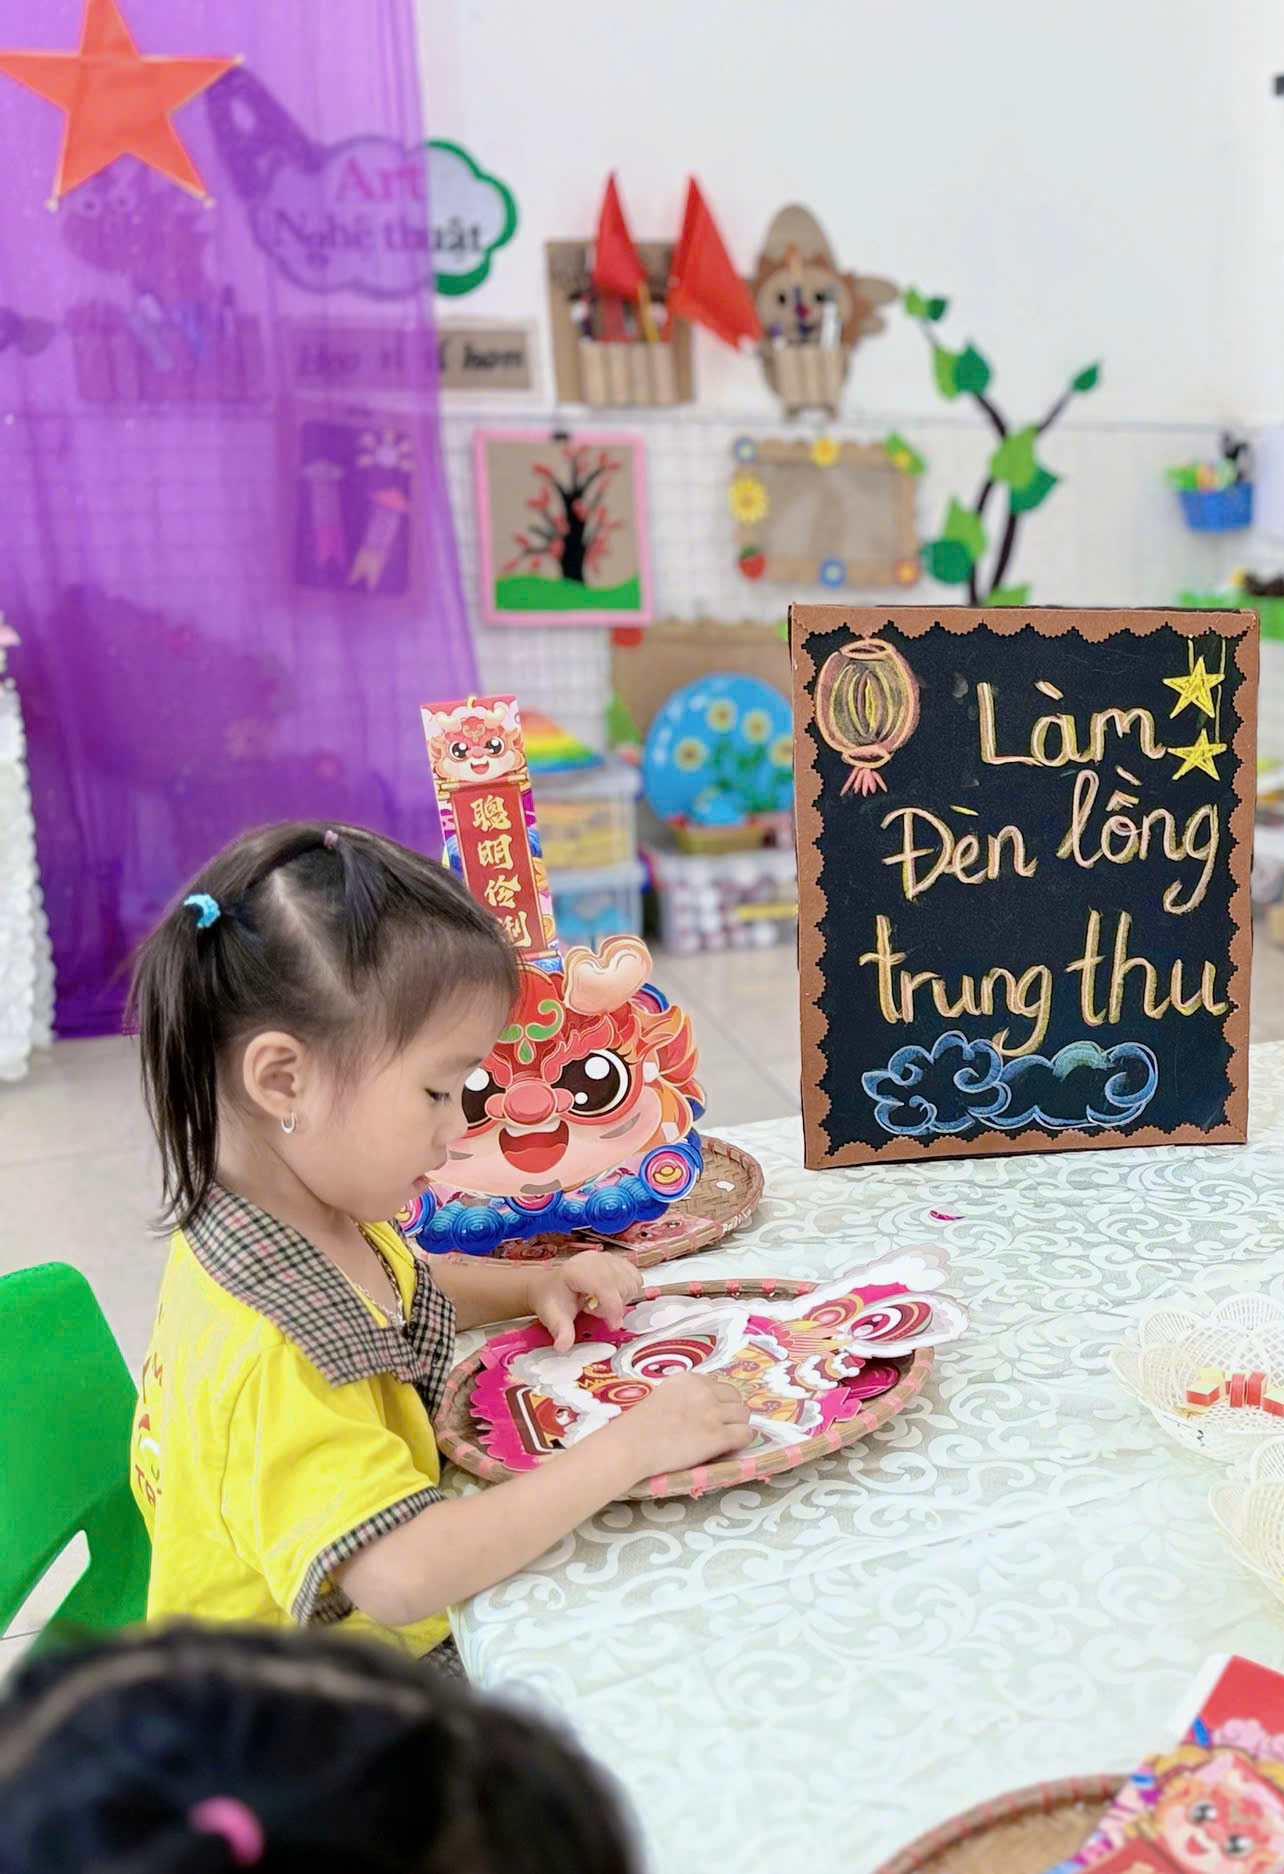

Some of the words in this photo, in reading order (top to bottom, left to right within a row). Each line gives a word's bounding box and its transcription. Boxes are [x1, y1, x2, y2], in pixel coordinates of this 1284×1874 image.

[334, 154, 426, 203] Art
[977, 680, 1168, 768] Làm
[881, 805, 1039, 901] Đèn
[1056, 765, 1220, 915] lồng
[859, 913, 1053, 1057] trung
[1065, 908, 1229, 1027] thu
